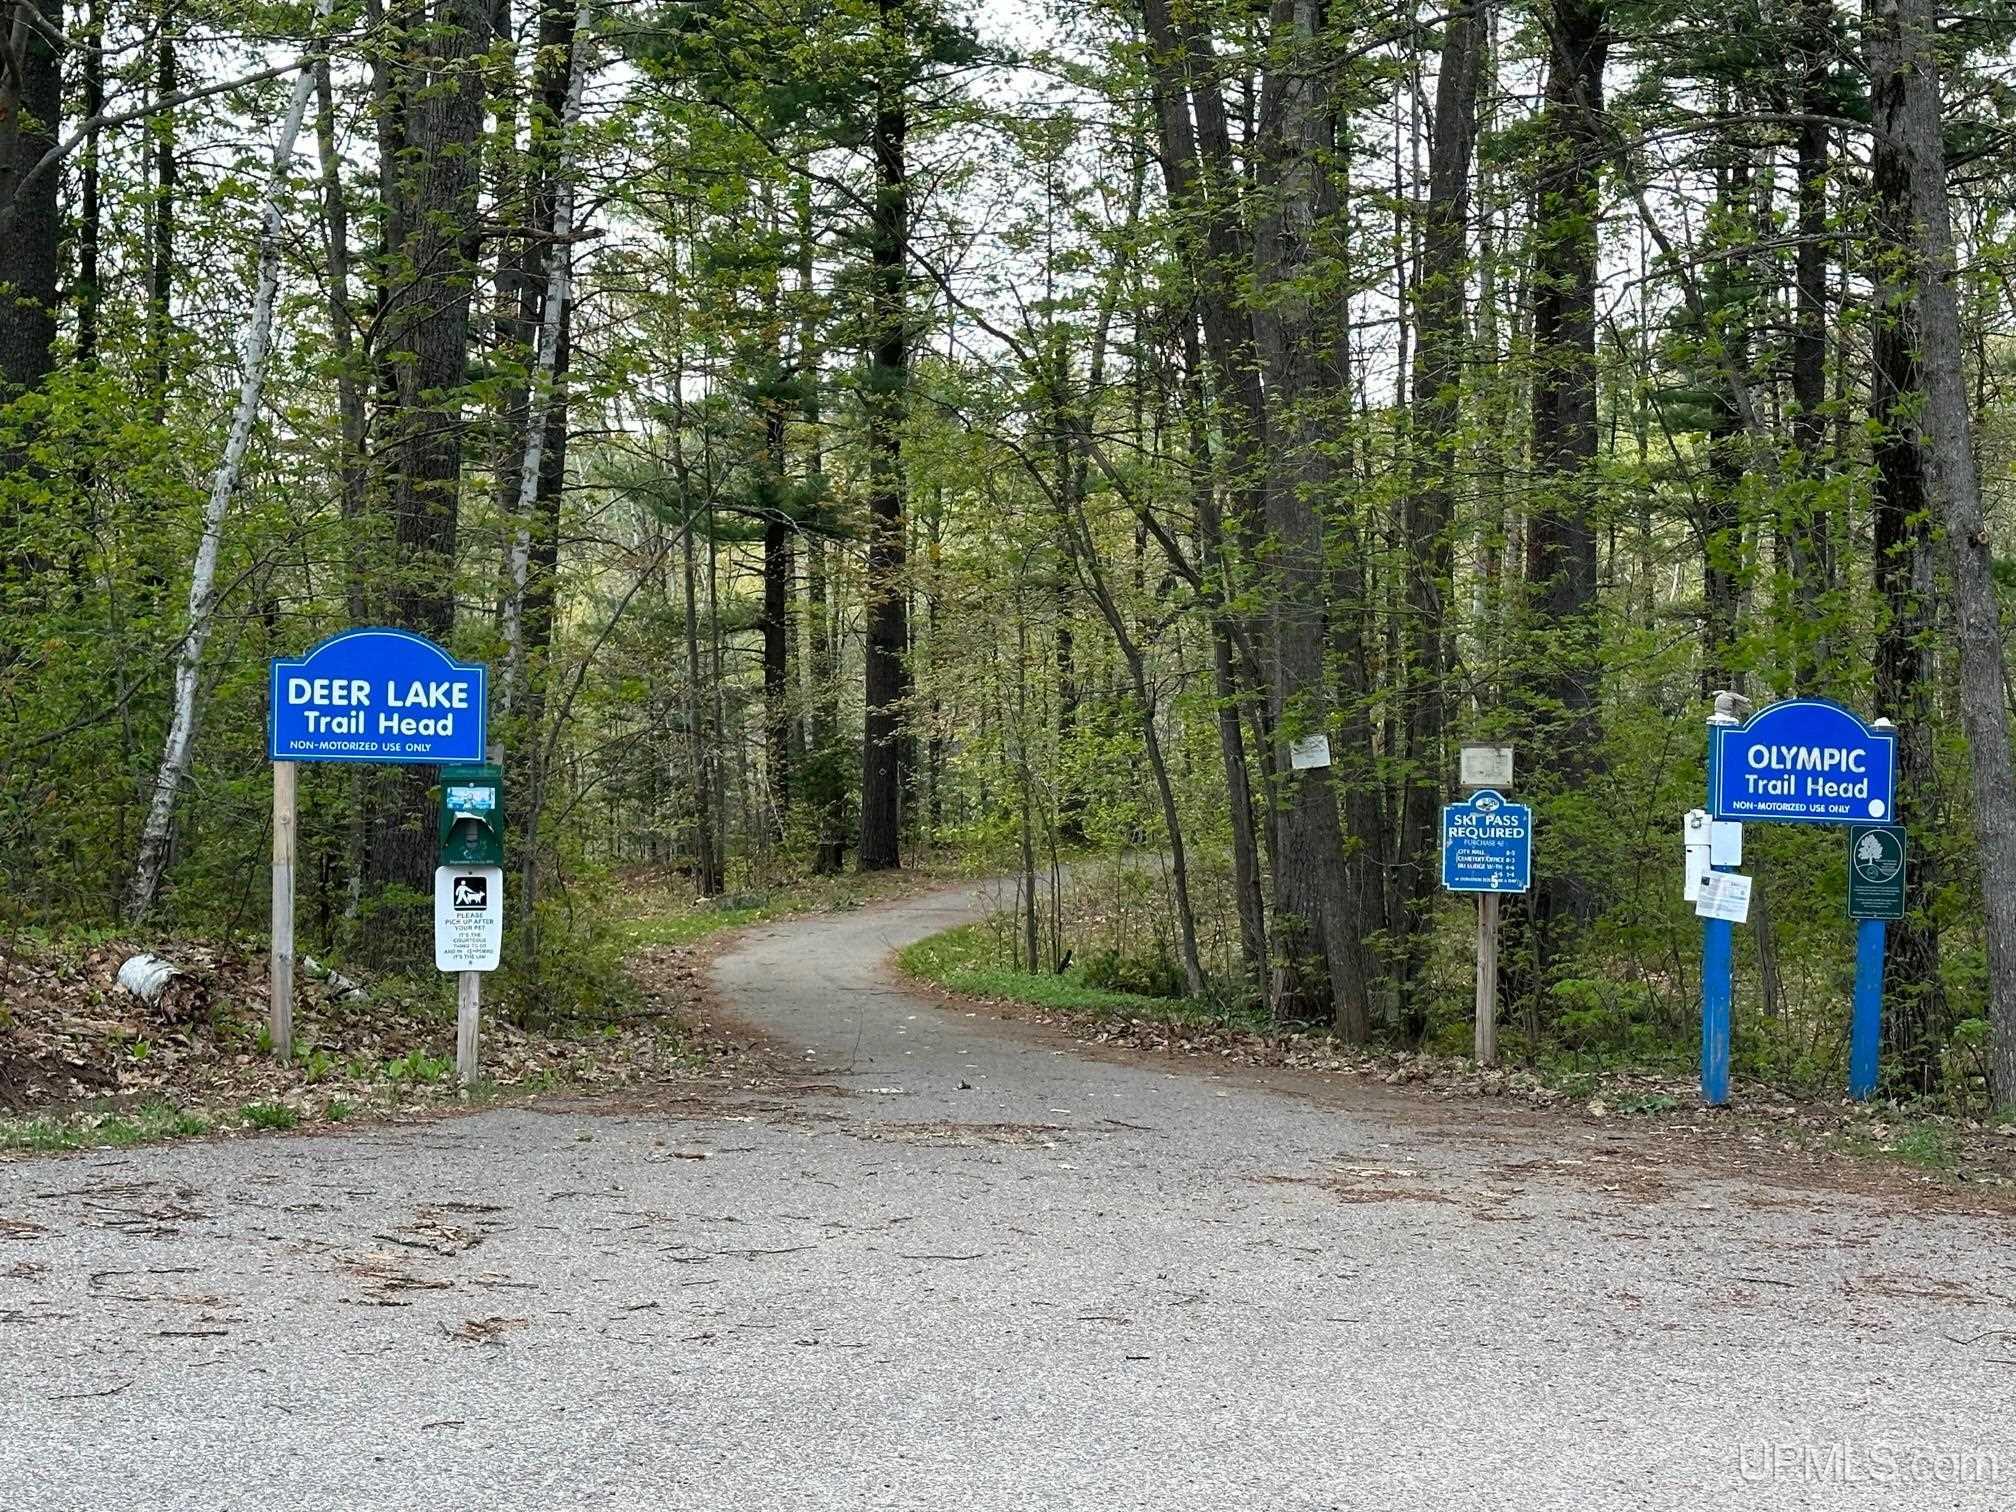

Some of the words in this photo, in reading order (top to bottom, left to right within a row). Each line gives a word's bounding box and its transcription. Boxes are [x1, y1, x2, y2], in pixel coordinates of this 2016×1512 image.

[288, 678, 371, 706] DEER
[388, 680, 469, 708] LAKE
[304, 710, 365, 734] Trail
[378, 712, 453, 736] Head
[290, 740, 378, 752] NON-MOTORIZED
[382, 742, 401, 752] USE
[406, 743, 432, 753] ONLY
[1747, 744, 1867, 773] OLYMPIC
[1745, 774, 1796, 796] Trail
[1807, 776, 1868, 798] Head
[1733, 801, 1806, 812] NON-MOTORIZED
[1809, 803, 1825, 812] USE
[1828, 804, 1850, 814] ONLY
[1454, 814, 1477, 826] SKI
[1485, 815, 1519, 826] PASS
[1448, 827, 1525, 839] REQUIRED
